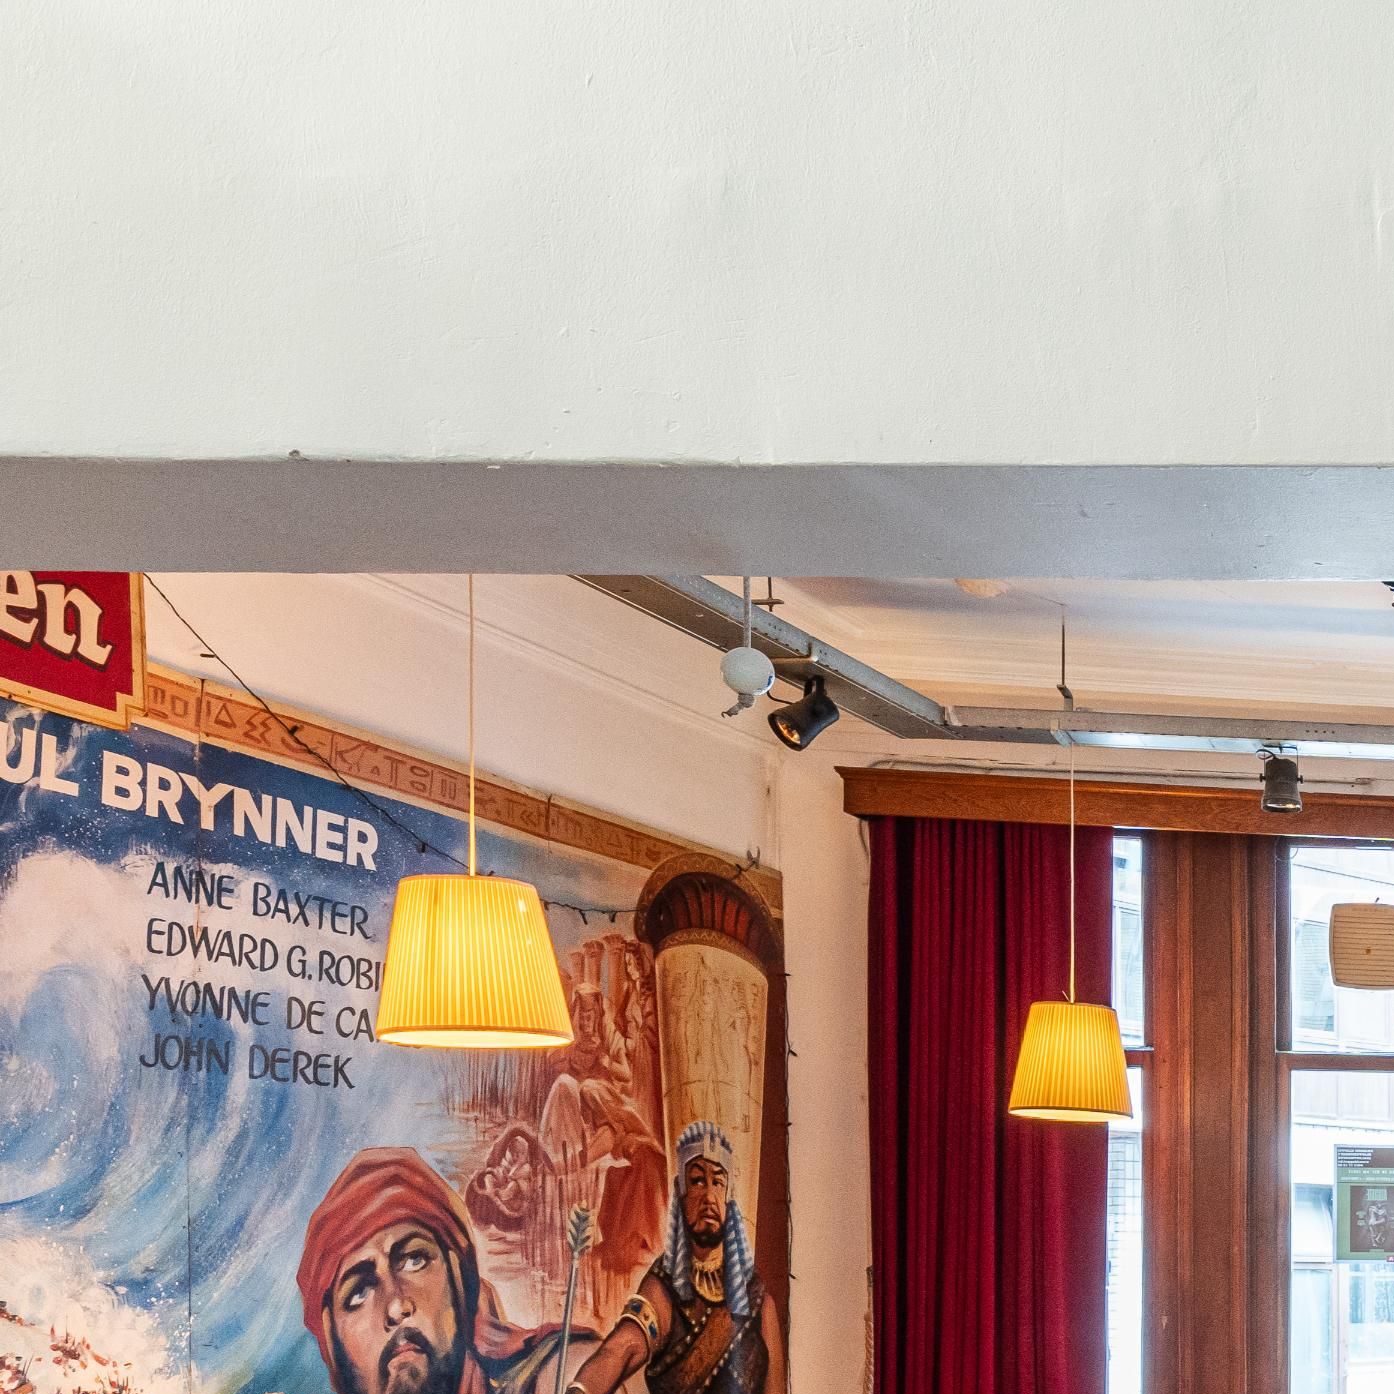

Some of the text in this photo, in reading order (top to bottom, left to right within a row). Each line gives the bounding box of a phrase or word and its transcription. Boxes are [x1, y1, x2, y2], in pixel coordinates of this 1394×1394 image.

[0, 570, 113, 666] en
[0, 721, 380, 871] UL BRYNNER
[147, 861, 373, 940] ANNE BAXTER
[146, 917, 279, 972] EDWARD
[318, 949, 386, 993] ROBI
[141, 973, 376, 1043] YVONNE DE CA
[139, 1033, 356, 1090] JOHN DEREK
